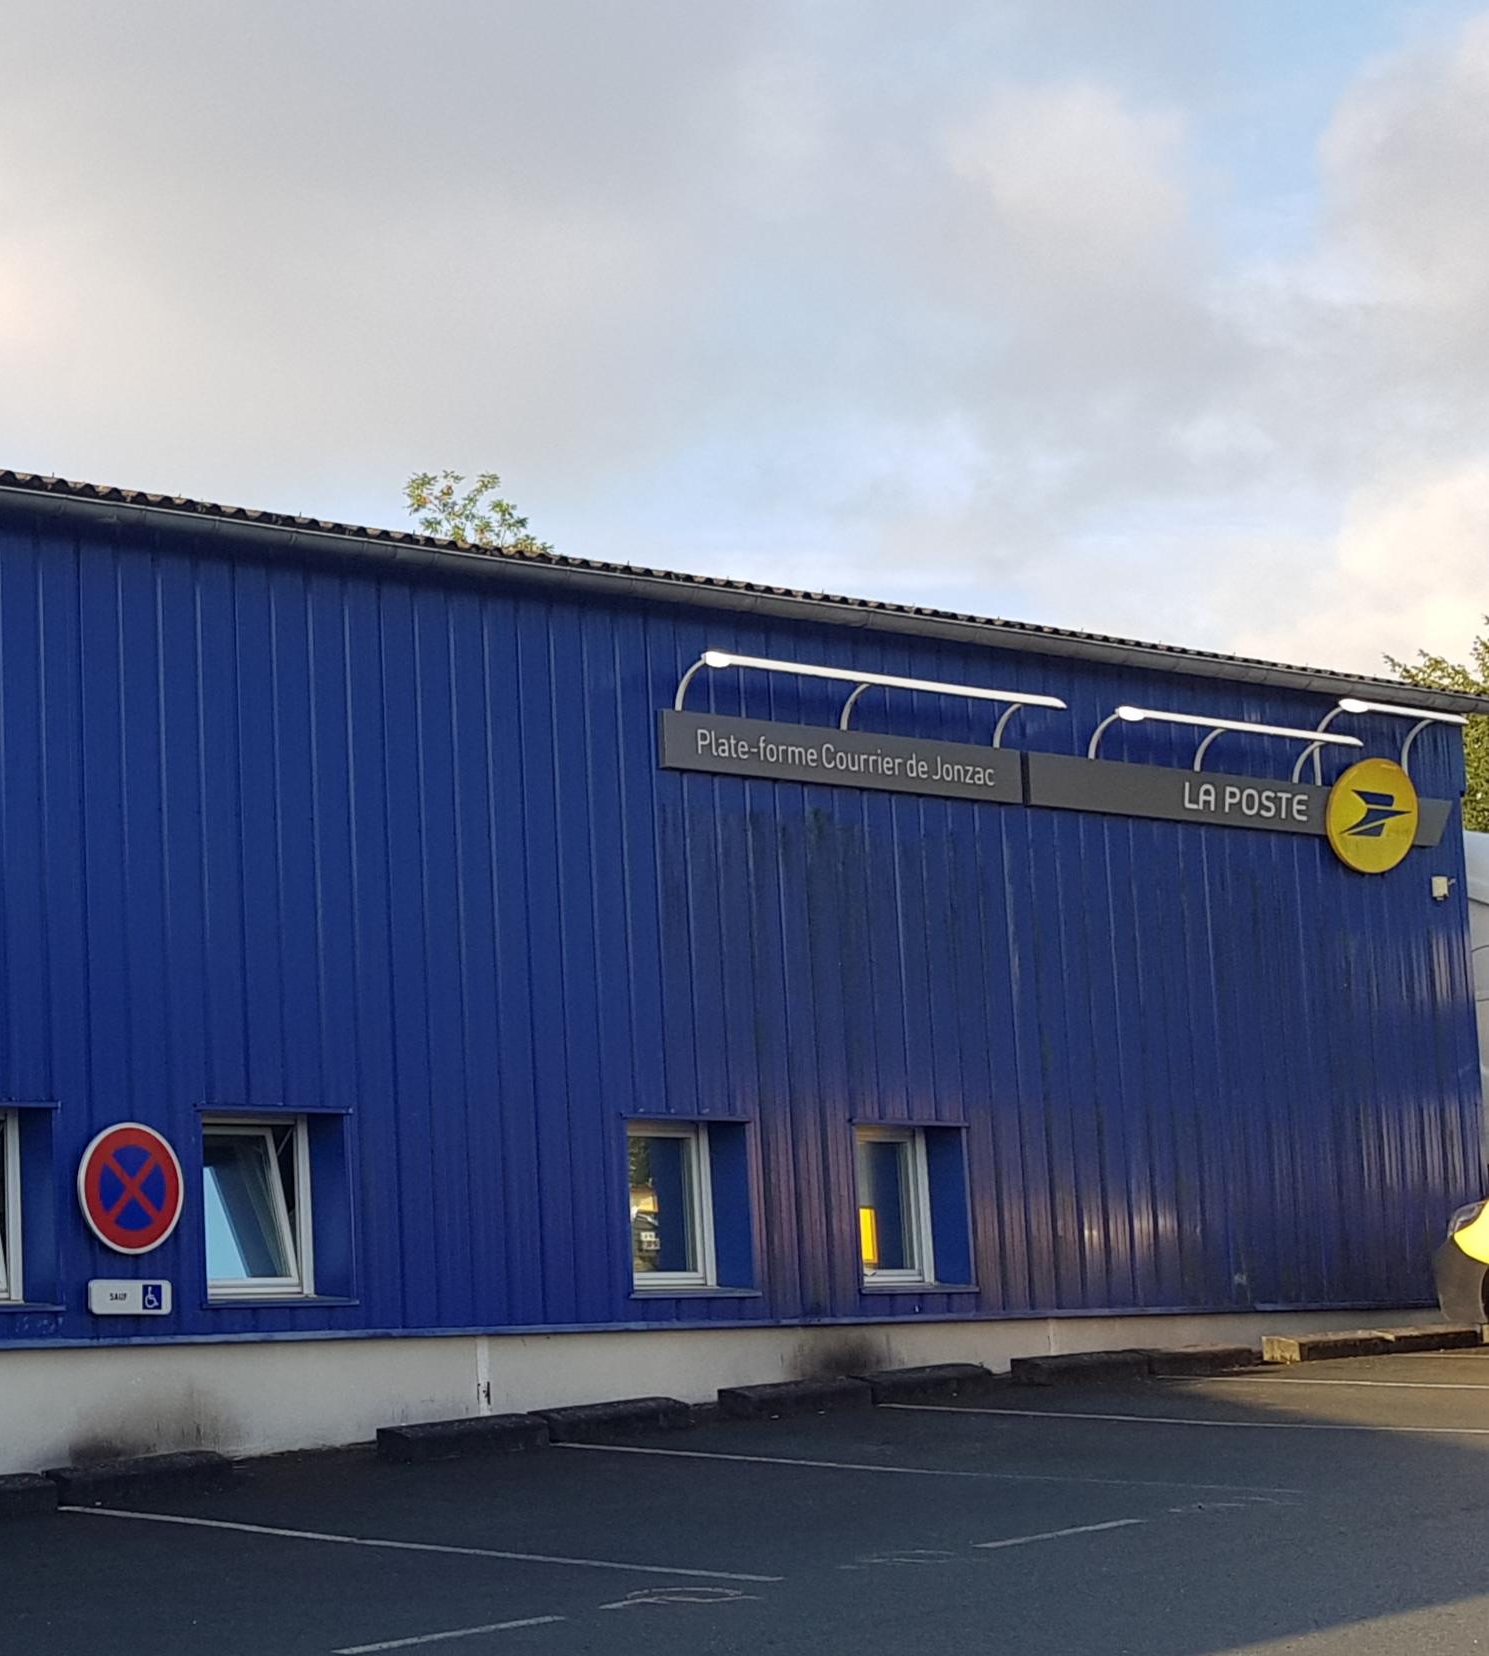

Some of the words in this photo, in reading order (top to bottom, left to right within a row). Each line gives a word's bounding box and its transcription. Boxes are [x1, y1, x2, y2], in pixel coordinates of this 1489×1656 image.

[696, 729, 817, 767] Plate-forme
[821, 742, 903, 777] Courrier
[906, 754, 929, 779] de
[931, 756, 995, 787] Jonzac
[1183, 781, 1216, 811] LA
[1224, 786, 1309, 822] POSTE
